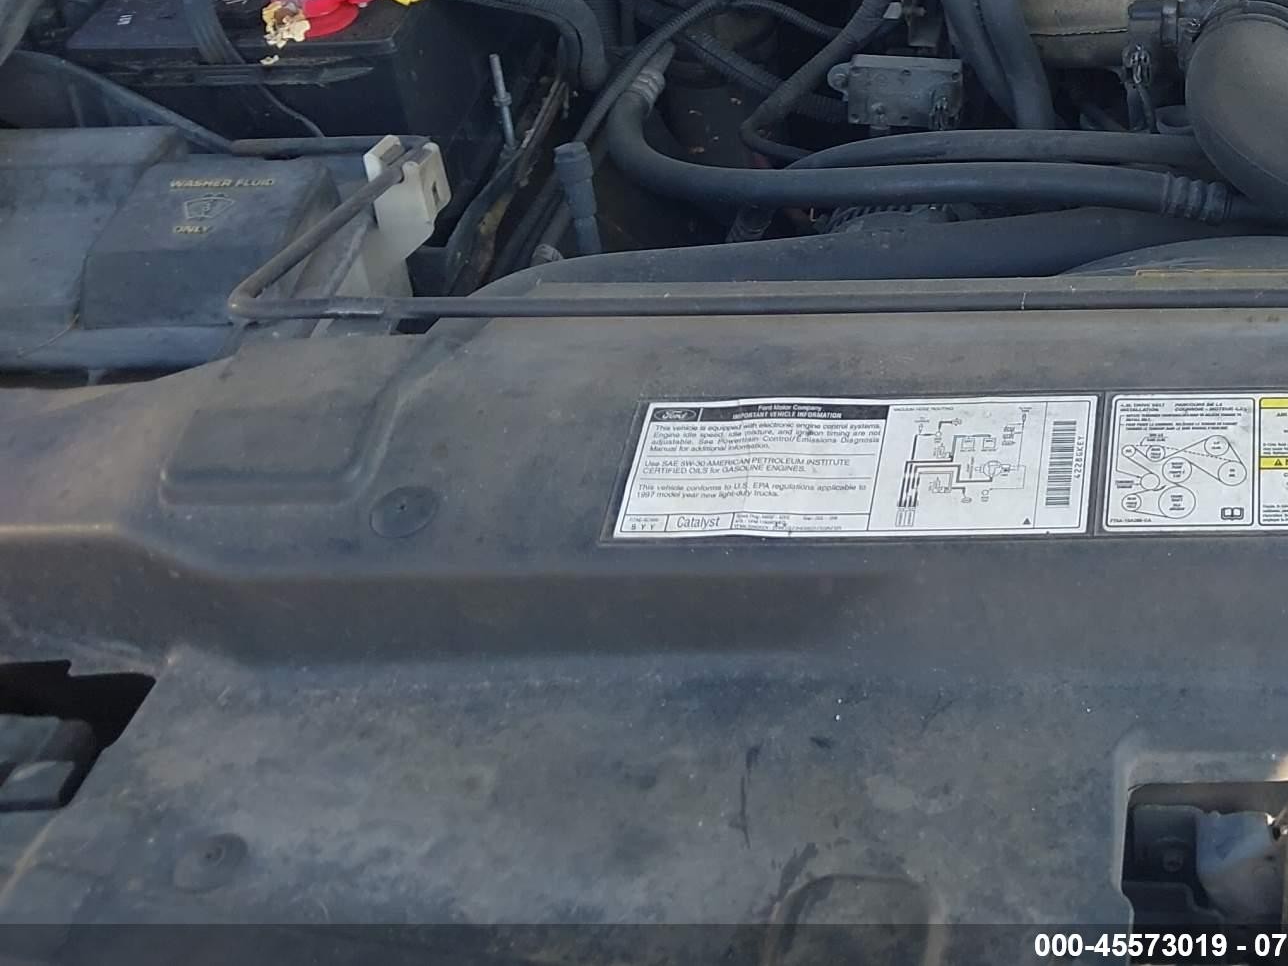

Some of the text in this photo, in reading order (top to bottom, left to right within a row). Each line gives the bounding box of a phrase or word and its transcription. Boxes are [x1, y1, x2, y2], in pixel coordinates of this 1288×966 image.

[170, 178, 274, 188] WASHER FLUID
[793, 404, 822, 412] Company
[661, 409, 688, 420] Ford
[732, 411, 768, 420] IMPORTANT
[796, 411, 842, 419] INFORMATION
[707, 457, 750, 467] AMERICAN
[751, 457, 805, 465] PETROLEUM
[806, 458, 850, 466] INSTITUTE
[676, 515, 720, 529] Catalyst
